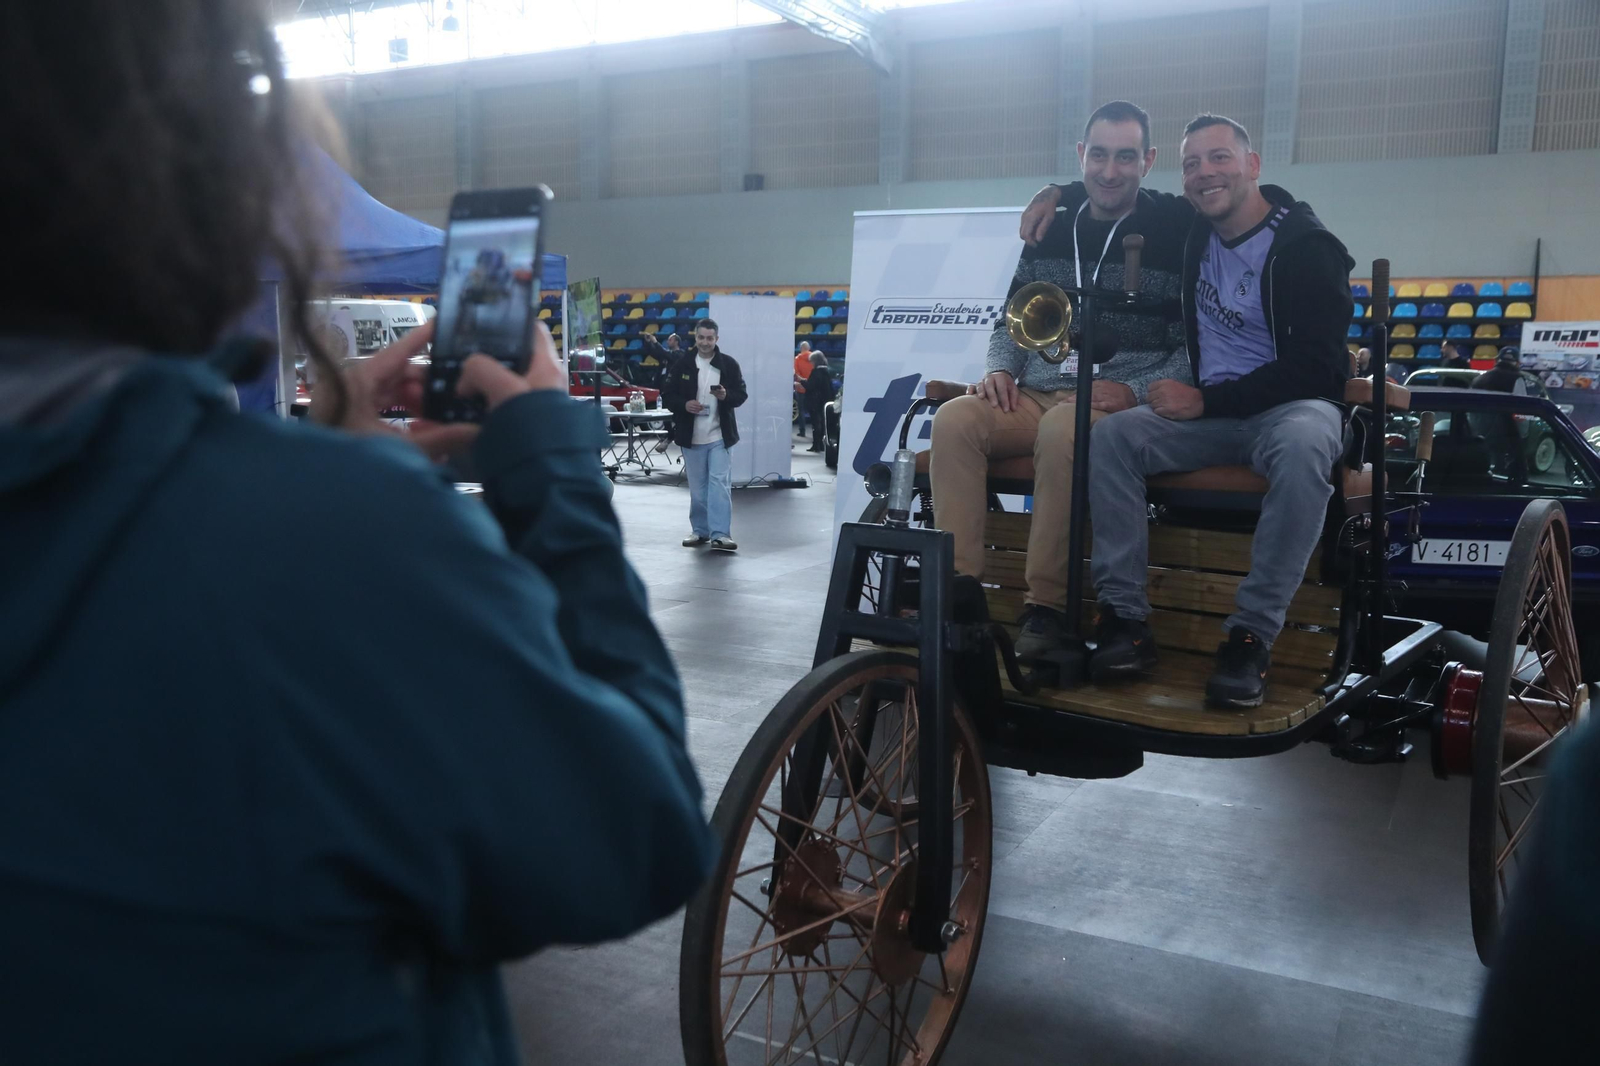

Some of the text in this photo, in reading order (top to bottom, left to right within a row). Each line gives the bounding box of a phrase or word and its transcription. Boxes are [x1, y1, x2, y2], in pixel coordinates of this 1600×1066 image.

[932, 302, 982, 315] Escudería
[391, 316, 418, 324] LANCIA
[1532, 329, 1600, 342] mar
